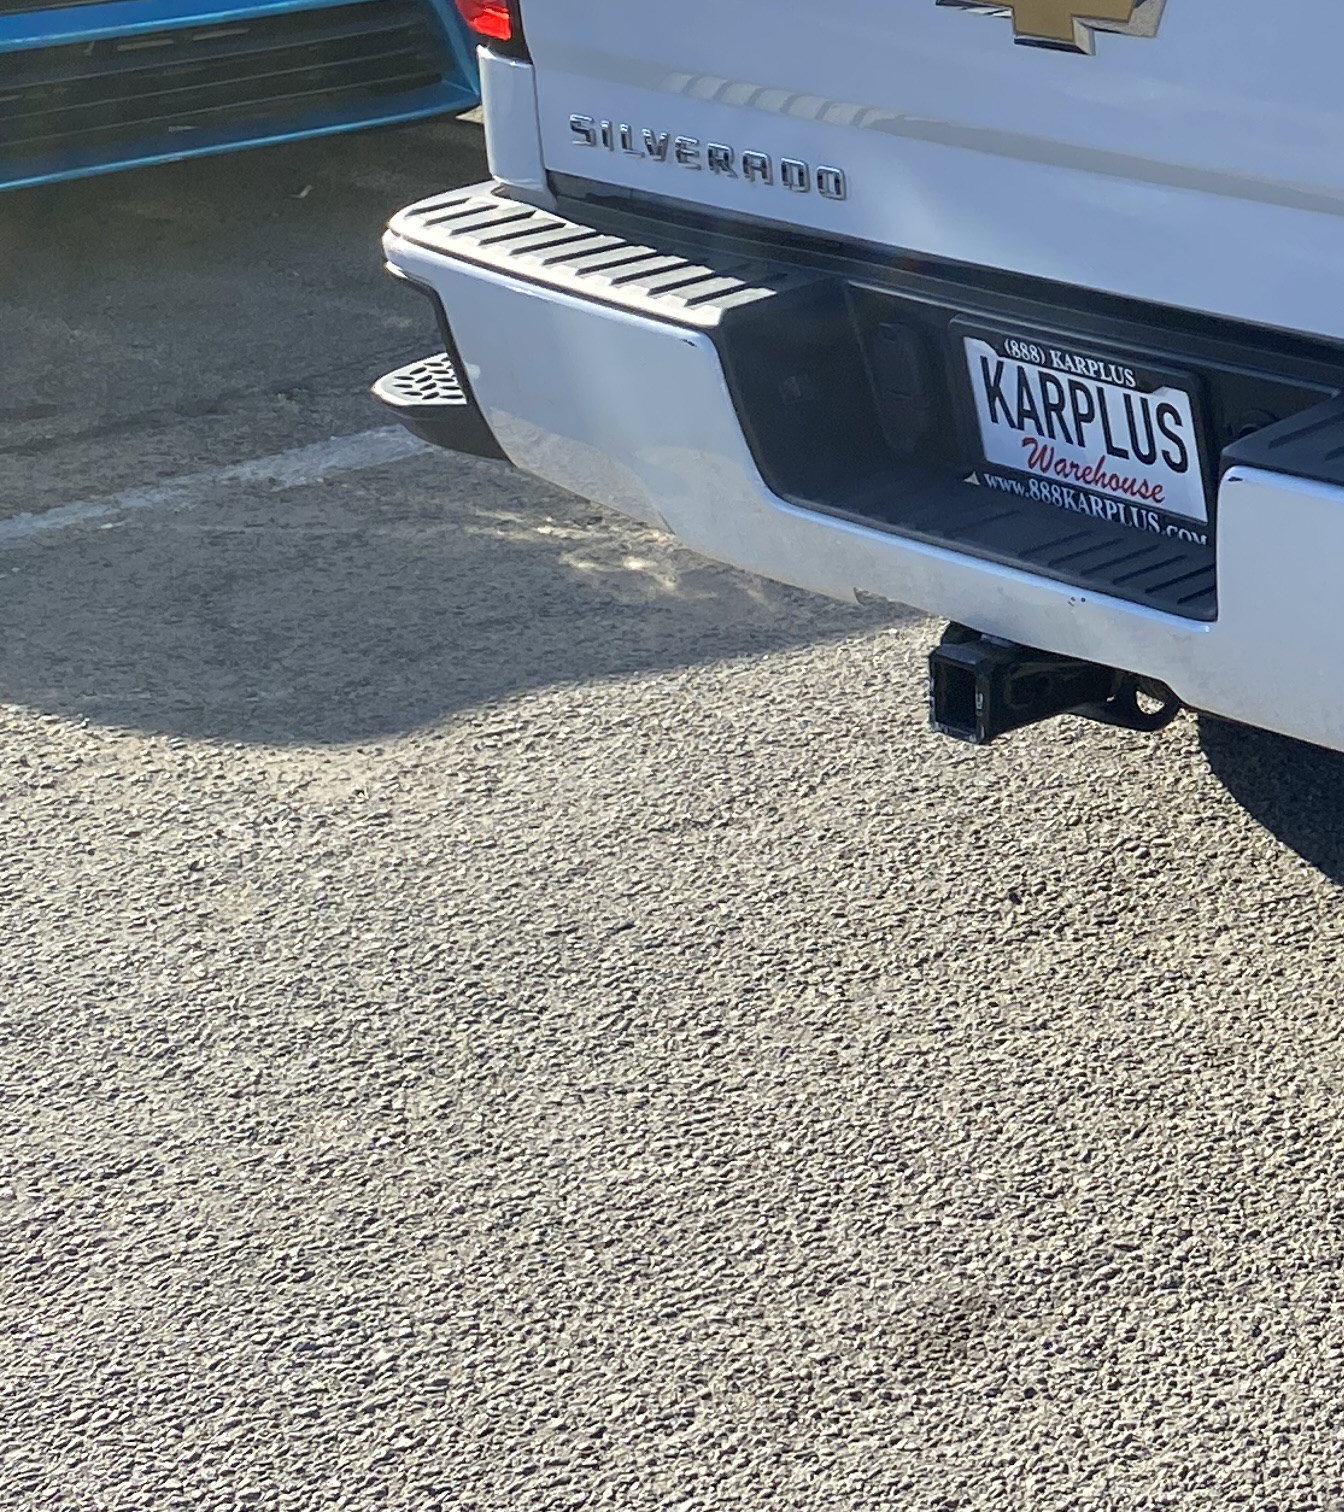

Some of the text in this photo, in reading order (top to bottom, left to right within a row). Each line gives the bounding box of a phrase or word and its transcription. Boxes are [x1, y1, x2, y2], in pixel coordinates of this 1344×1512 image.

[569, 113, 848, 201] SILVERADO
[1003, 338, 1137, 388] (888) KARPLUS
[980, 355, 1189, 474] KARPLUS
[1021, 436, 1166, 504] Warehouse
